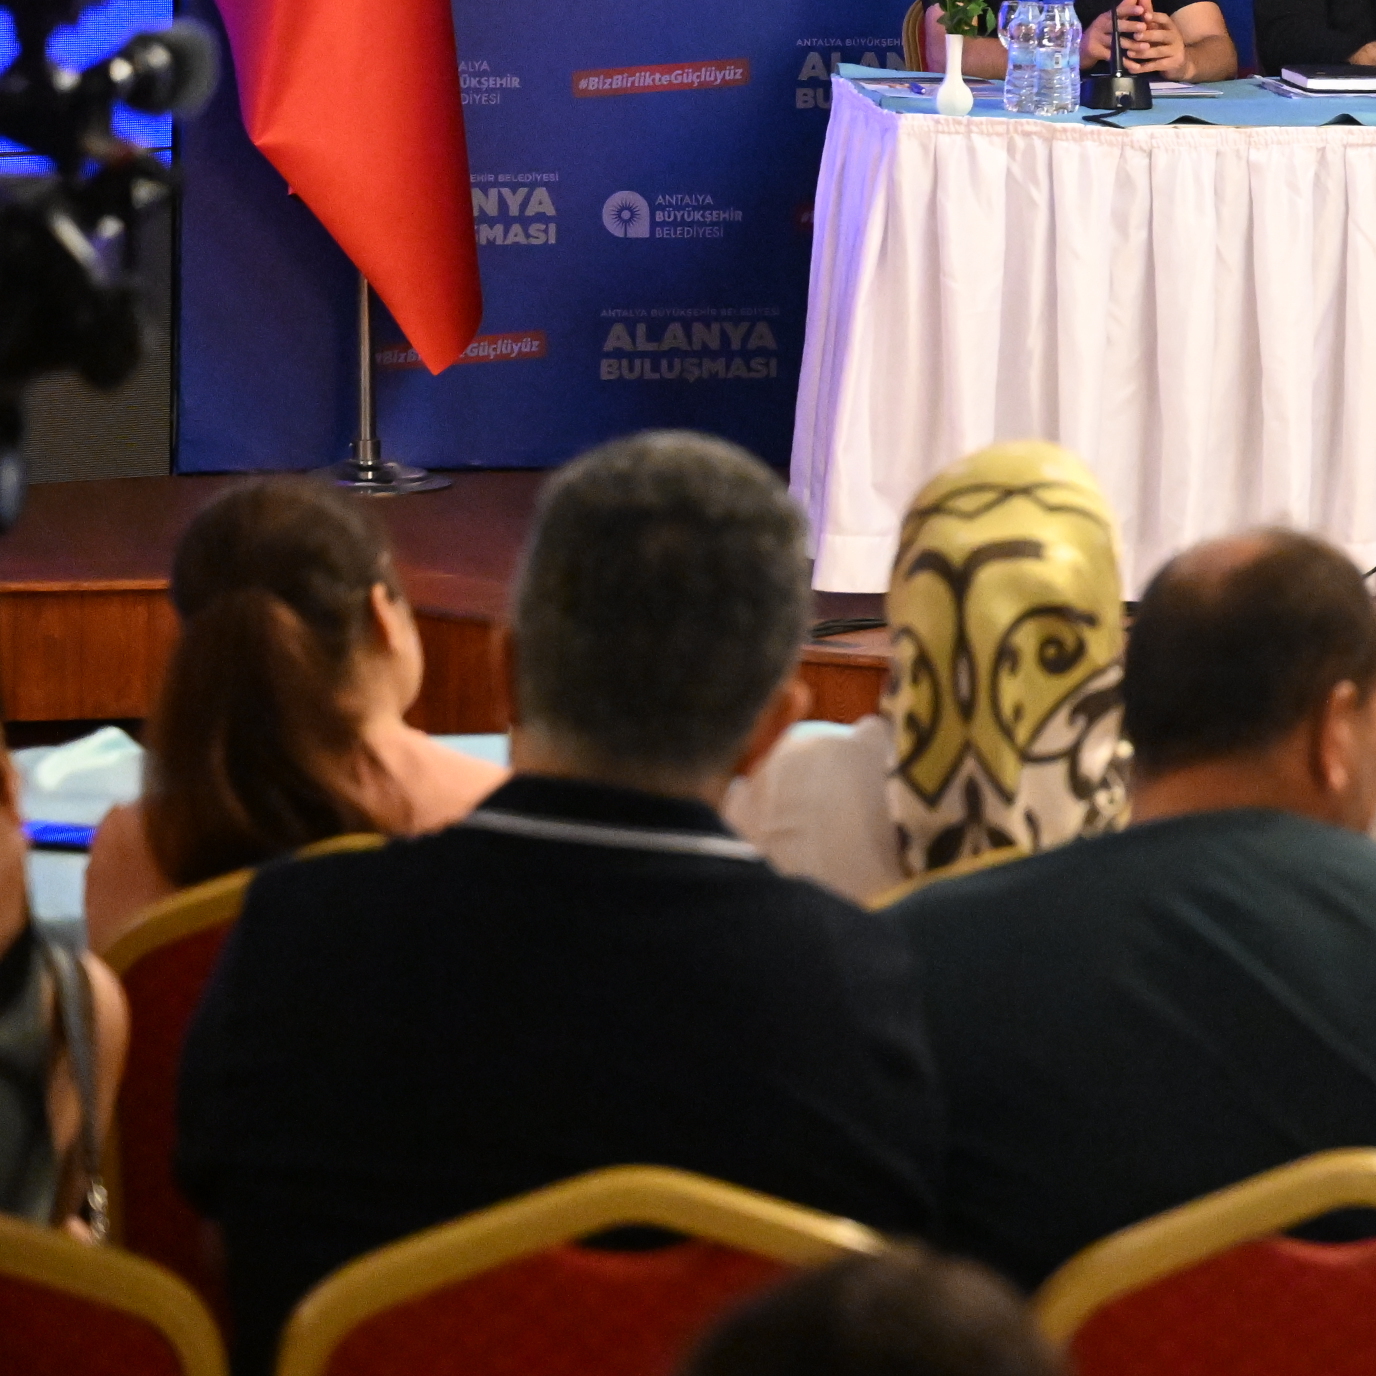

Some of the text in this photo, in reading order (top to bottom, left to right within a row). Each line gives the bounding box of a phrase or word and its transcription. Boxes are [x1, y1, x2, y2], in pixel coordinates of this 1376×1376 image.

[795, 37, 843, 47] ANTALYA
[579, 66, 742, 90] #BizBirlikteGüçlüyüz
[497, 171, 559, 183] BELEDİYESİ
[654, 194, 714, 206] ANTALYA
[655, 208, 742, 223] BÜYÜKŞEHİR
[654, 225, 723, 239] BELEDİYESİ
[602, 322, 779, 352] ALANYA
[600, 357, 779, 384] BULUŞMASI
